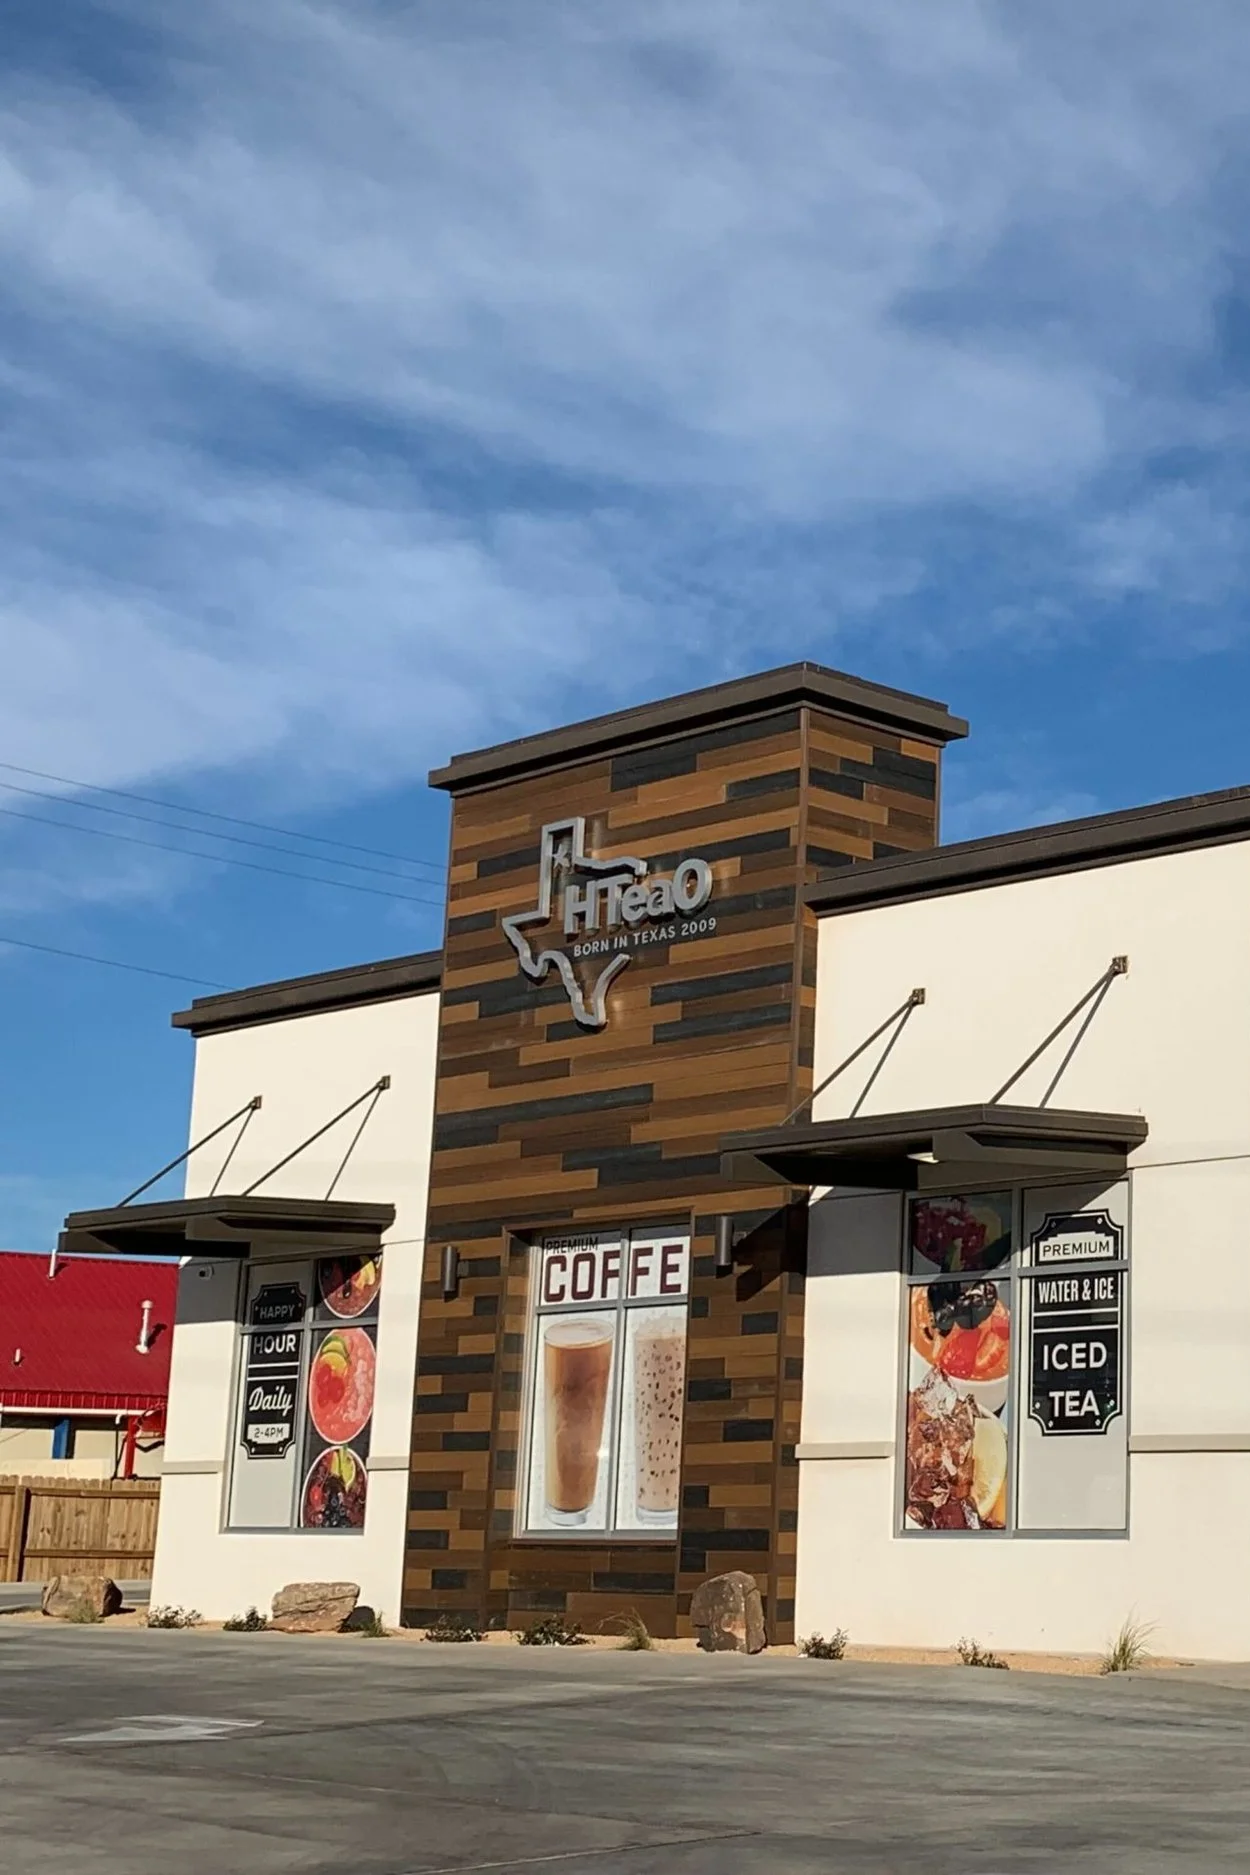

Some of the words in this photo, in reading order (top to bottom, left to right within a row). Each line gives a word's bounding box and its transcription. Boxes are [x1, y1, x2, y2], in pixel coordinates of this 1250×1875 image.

[563, 858, 713, 936] HTeaO
[573, 939, 610, 957] BORN
[613, 934, 628, 949] IN
[632, 929, 676, 946] TEXAS
[681, 918, 717, 937] 2009
[546, 1236, 599, 1255] PREMIUM
[1042, 1240, 1111, 1258] PREMIUM
[1038, 1279, 1079, 1304] WATER
[1081, 1280, 1091, 1301] &
[1094, 1276, 1115, 1300] ICE
[259, 1303, 295, 1319] HAPPY
[253, 1333, 297, 1355] HOUR
[1042, 1342, 1107, 1371] ICED
[248, 1386, 293, 1417] Daily
[1049, 1390, 1101, 1418] TEA
[253, 1427, 285, 1439] 2-4PM
